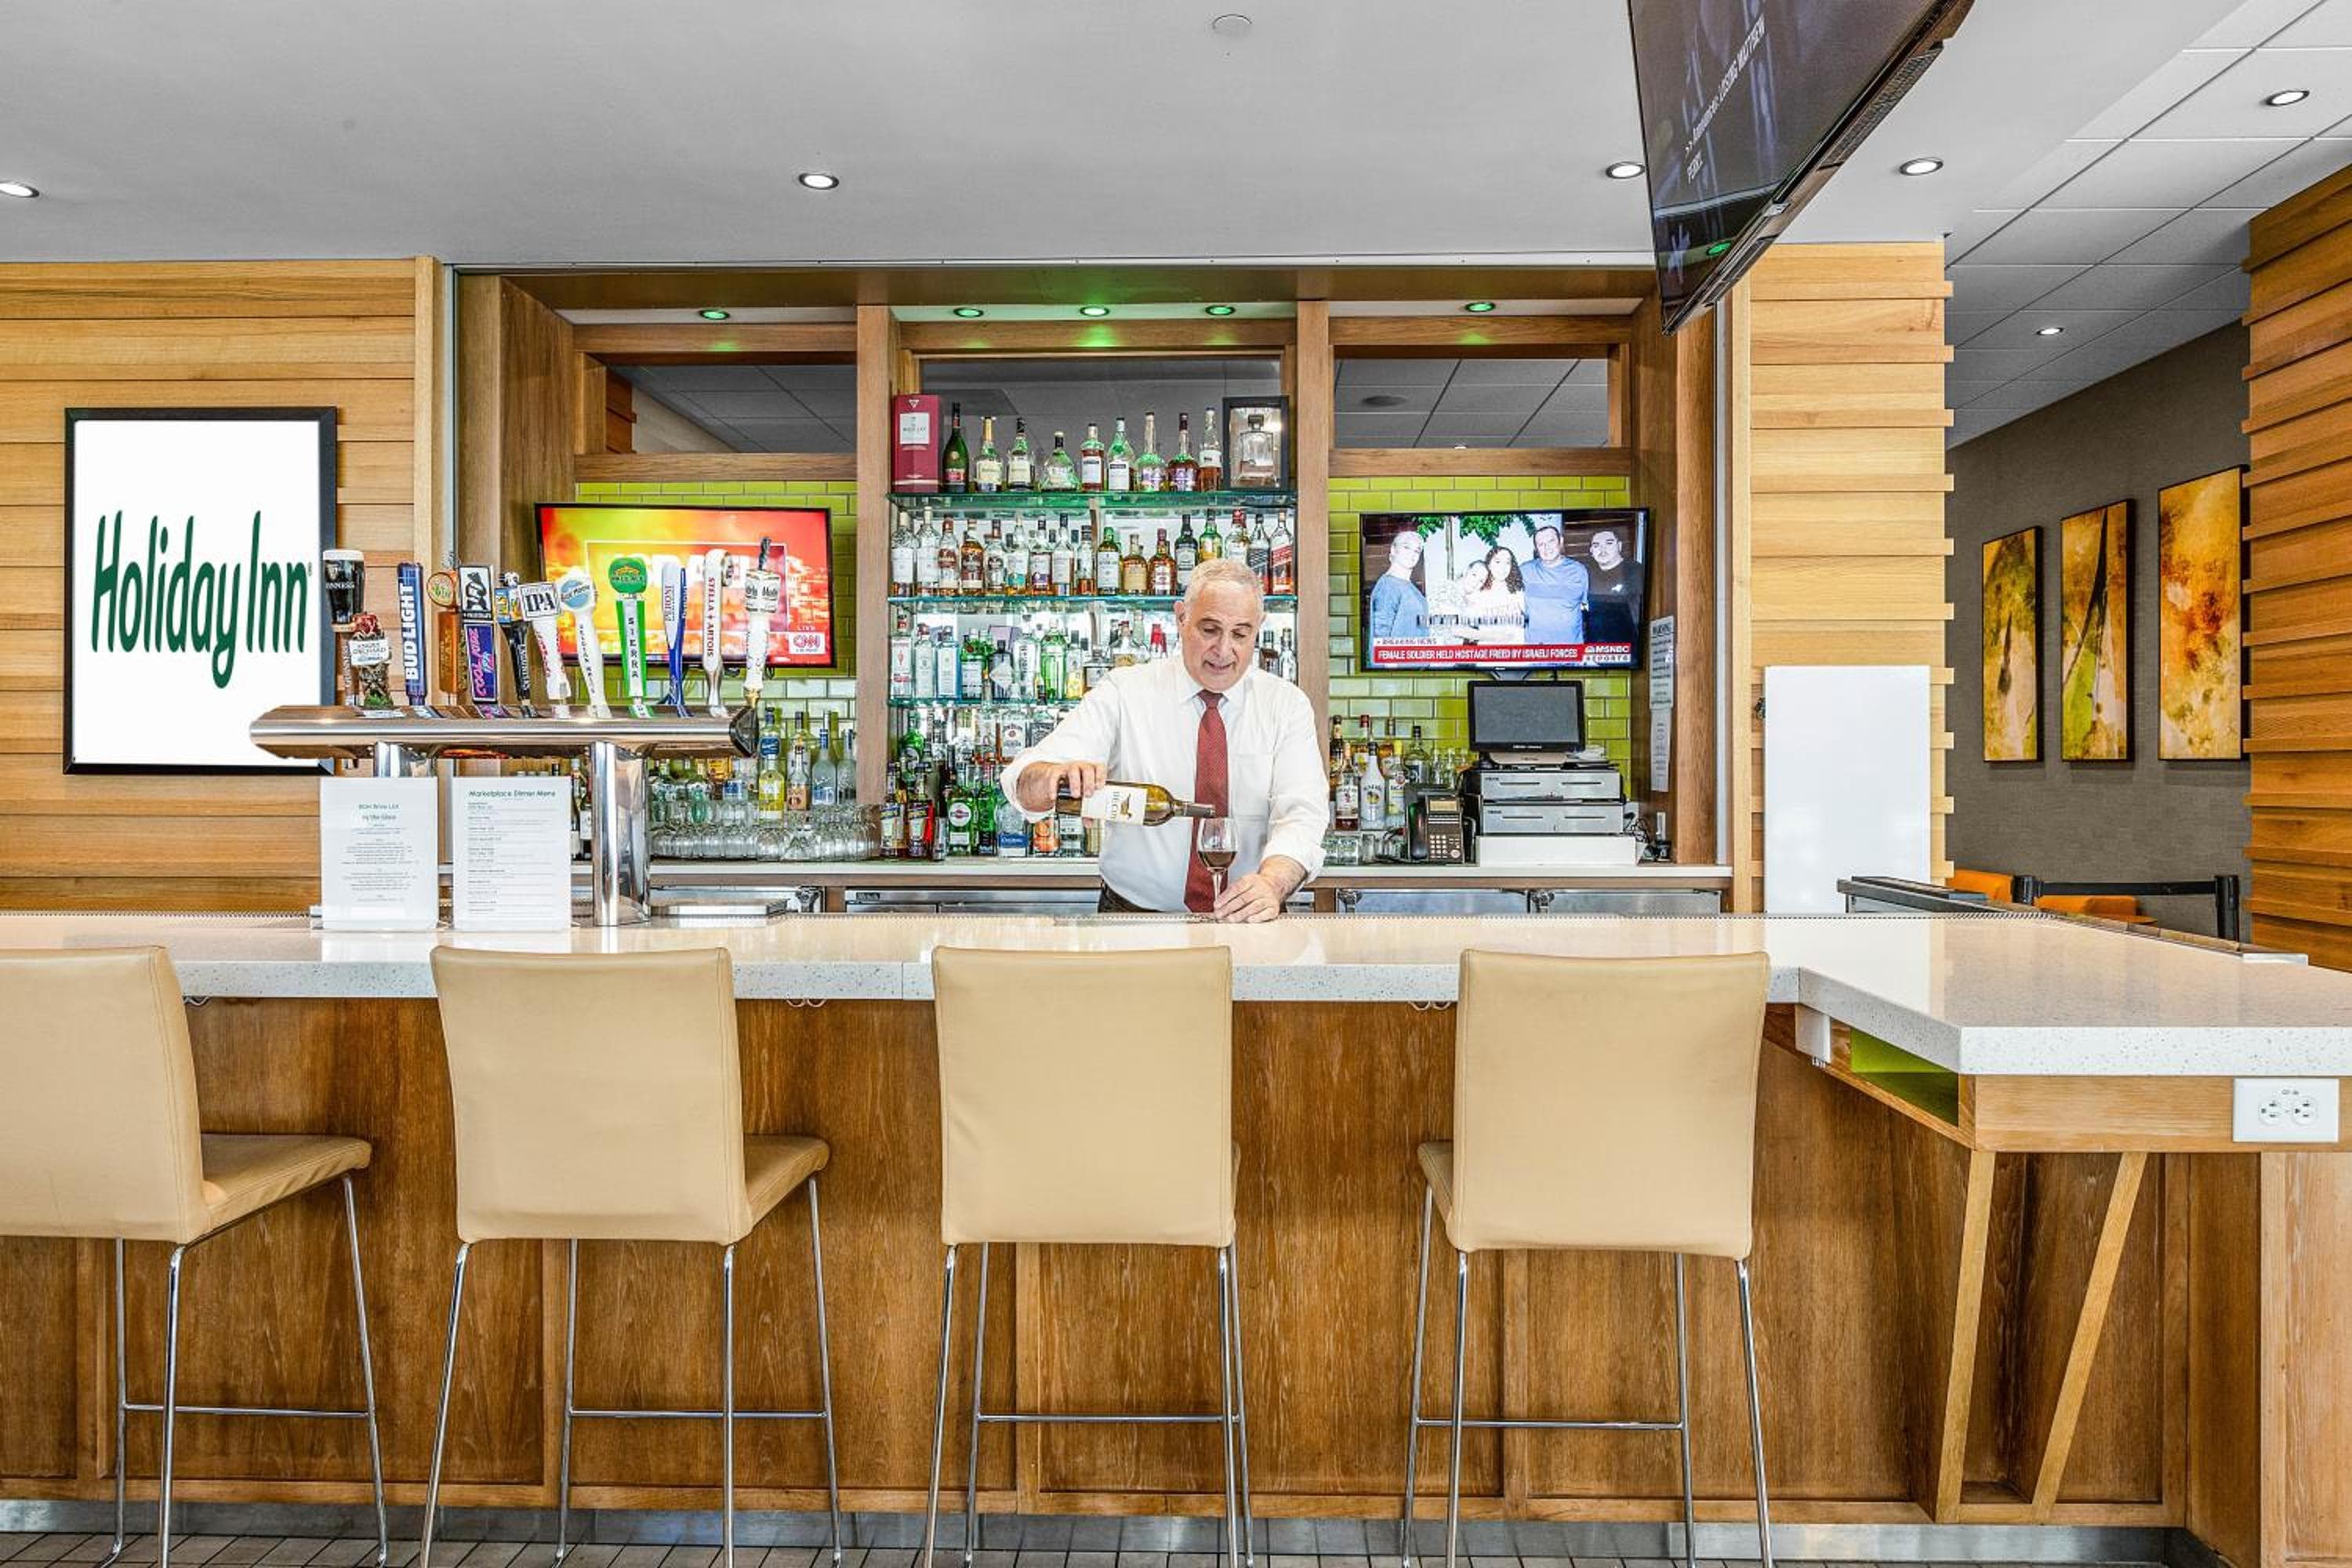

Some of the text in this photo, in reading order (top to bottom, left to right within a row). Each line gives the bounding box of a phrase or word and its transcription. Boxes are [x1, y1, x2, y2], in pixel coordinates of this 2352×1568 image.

[91, 510, 307, 688] Holiday Inn
[524, 592, 556, 612] IPA
[399, 583, 419, 681] BUD LIGHT
[793, 634, 821, 648] CNN
[628, 617, 639, 678] SIERRA
[1378, 648, 1578, 659] FEMALE SOLDIER HELD HOSTAGE FREED BY ISRAELI FORCES
[481, 651, 495, 673] IPA
[471, 663, 487, 697] COOL
[468, 789, 512, 798] Marketplace
